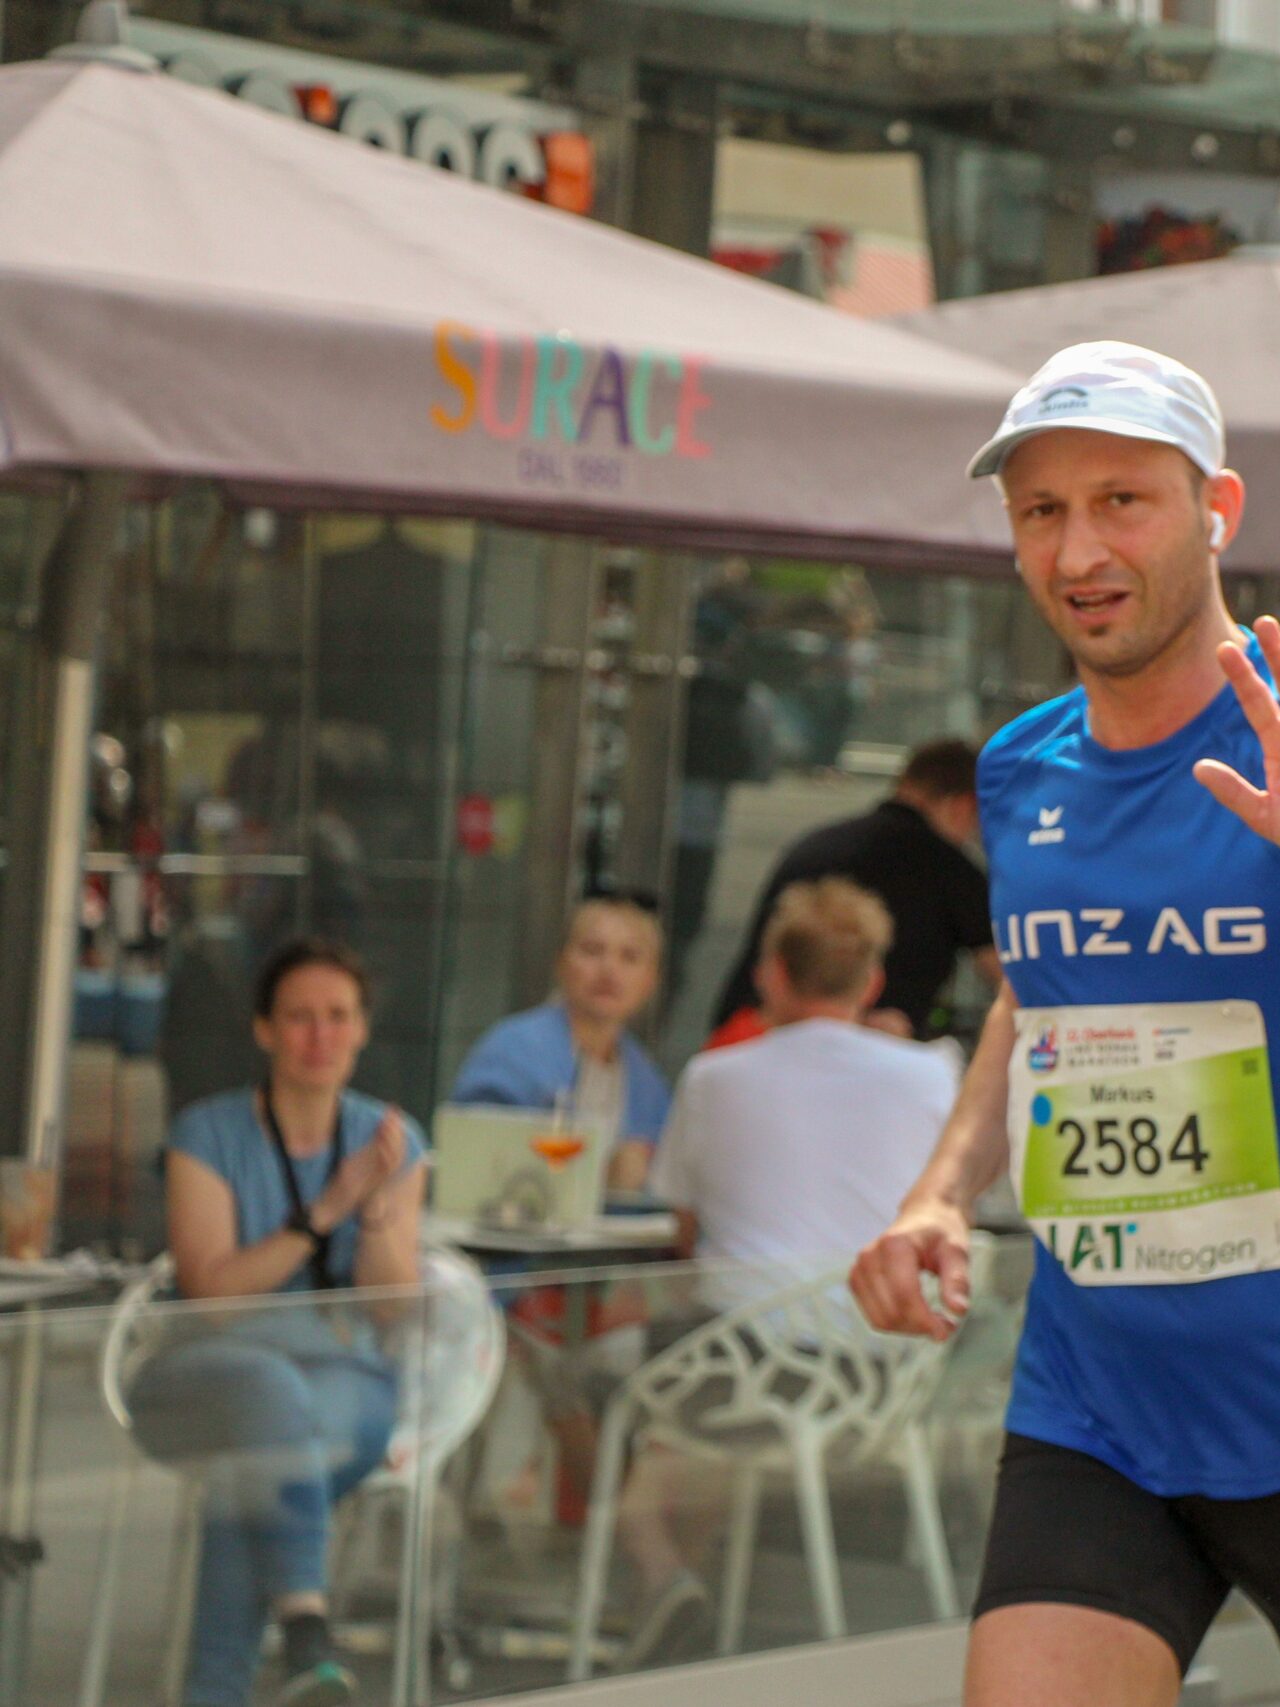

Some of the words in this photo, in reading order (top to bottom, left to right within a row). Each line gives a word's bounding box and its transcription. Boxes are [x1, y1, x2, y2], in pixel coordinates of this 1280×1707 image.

[427, 317, 714, 459] SURACE
[1147, 906, 1267, 956] AG
[1091, 1084, 1155, 1103] Markus
[1057, 1114, 1208, 1177] 2584
[1134, 1238, 1257, 1274] Nitrogen
